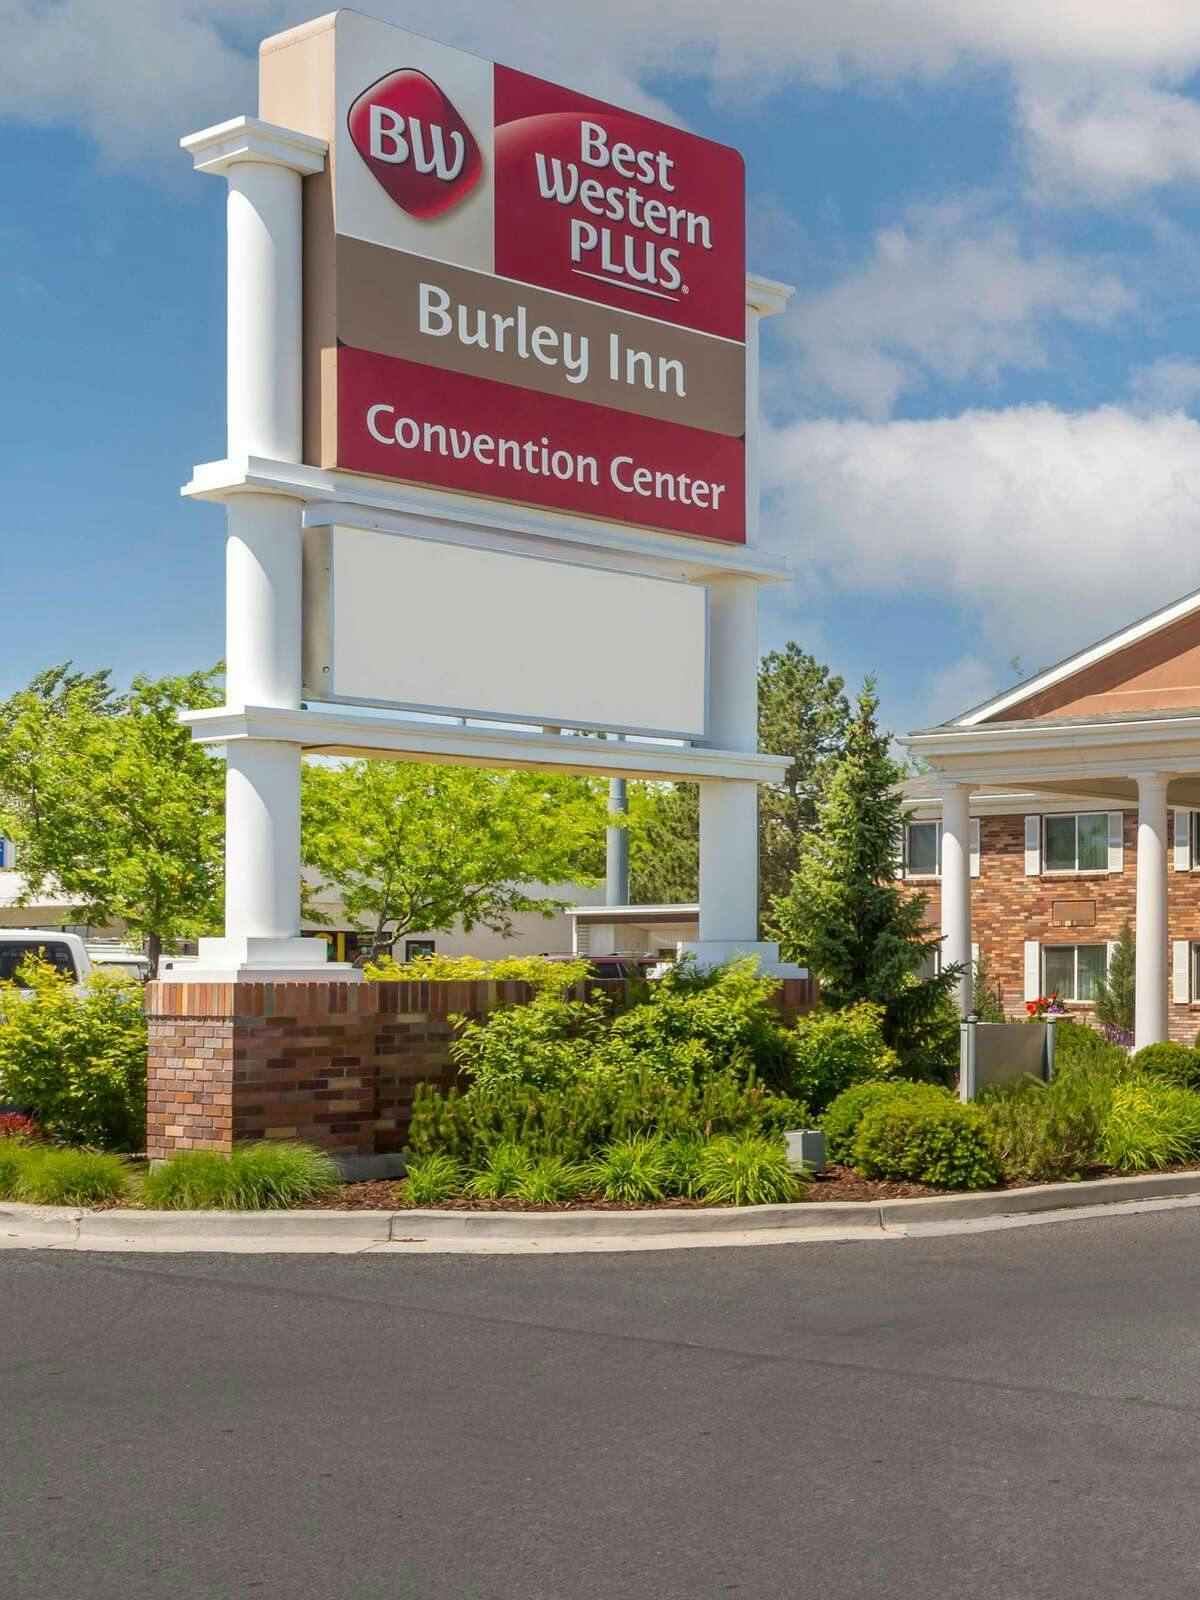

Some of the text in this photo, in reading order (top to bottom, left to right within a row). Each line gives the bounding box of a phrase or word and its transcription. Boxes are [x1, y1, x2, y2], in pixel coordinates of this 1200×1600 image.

[369, 104, 464, 181] BW
[580, 120, 675, 192] Best
[535, 152, 713, 249] Western
[419, 282, 687, 398] Burley Inn
[366, 404, 725, 510] Convention Center
